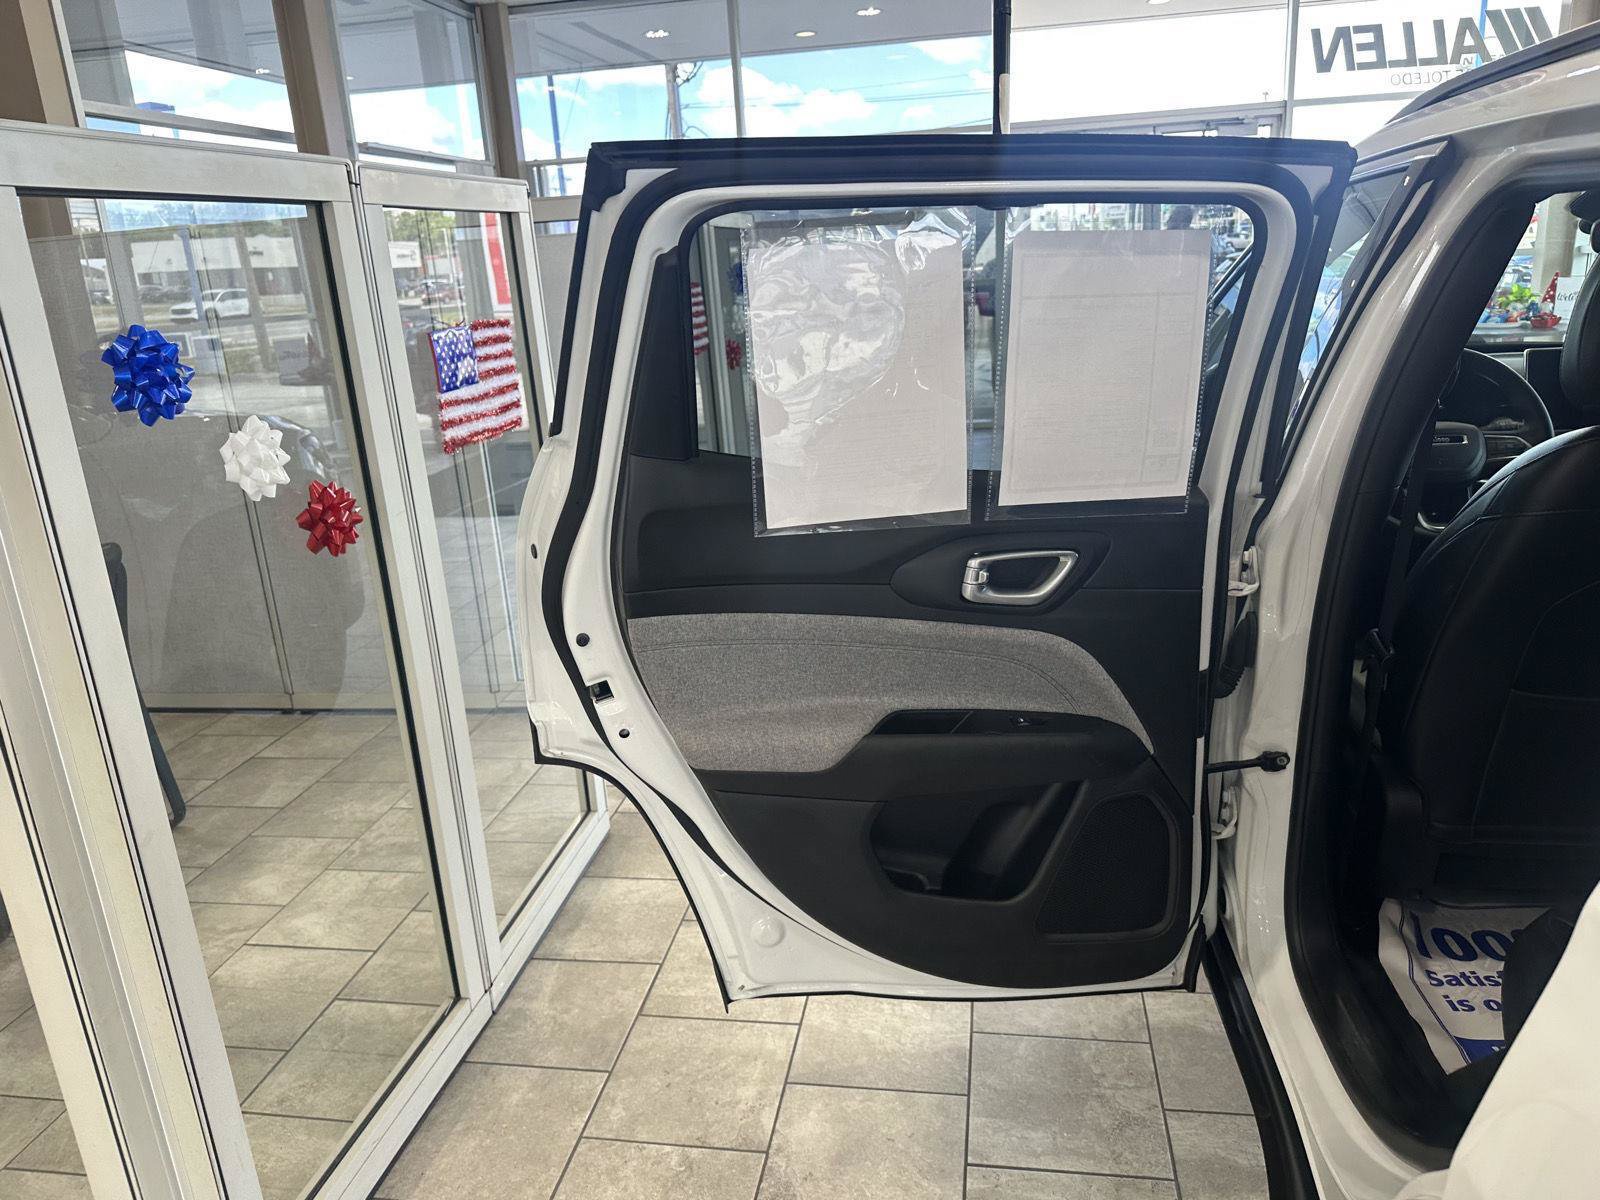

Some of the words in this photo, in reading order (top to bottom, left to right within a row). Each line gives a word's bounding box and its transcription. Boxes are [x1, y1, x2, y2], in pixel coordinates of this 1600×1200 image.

[1409, 911, 1524, 962] 100
[1442, 995, 1476, 1012] is
[1484, 999, 1503, 1012] o
